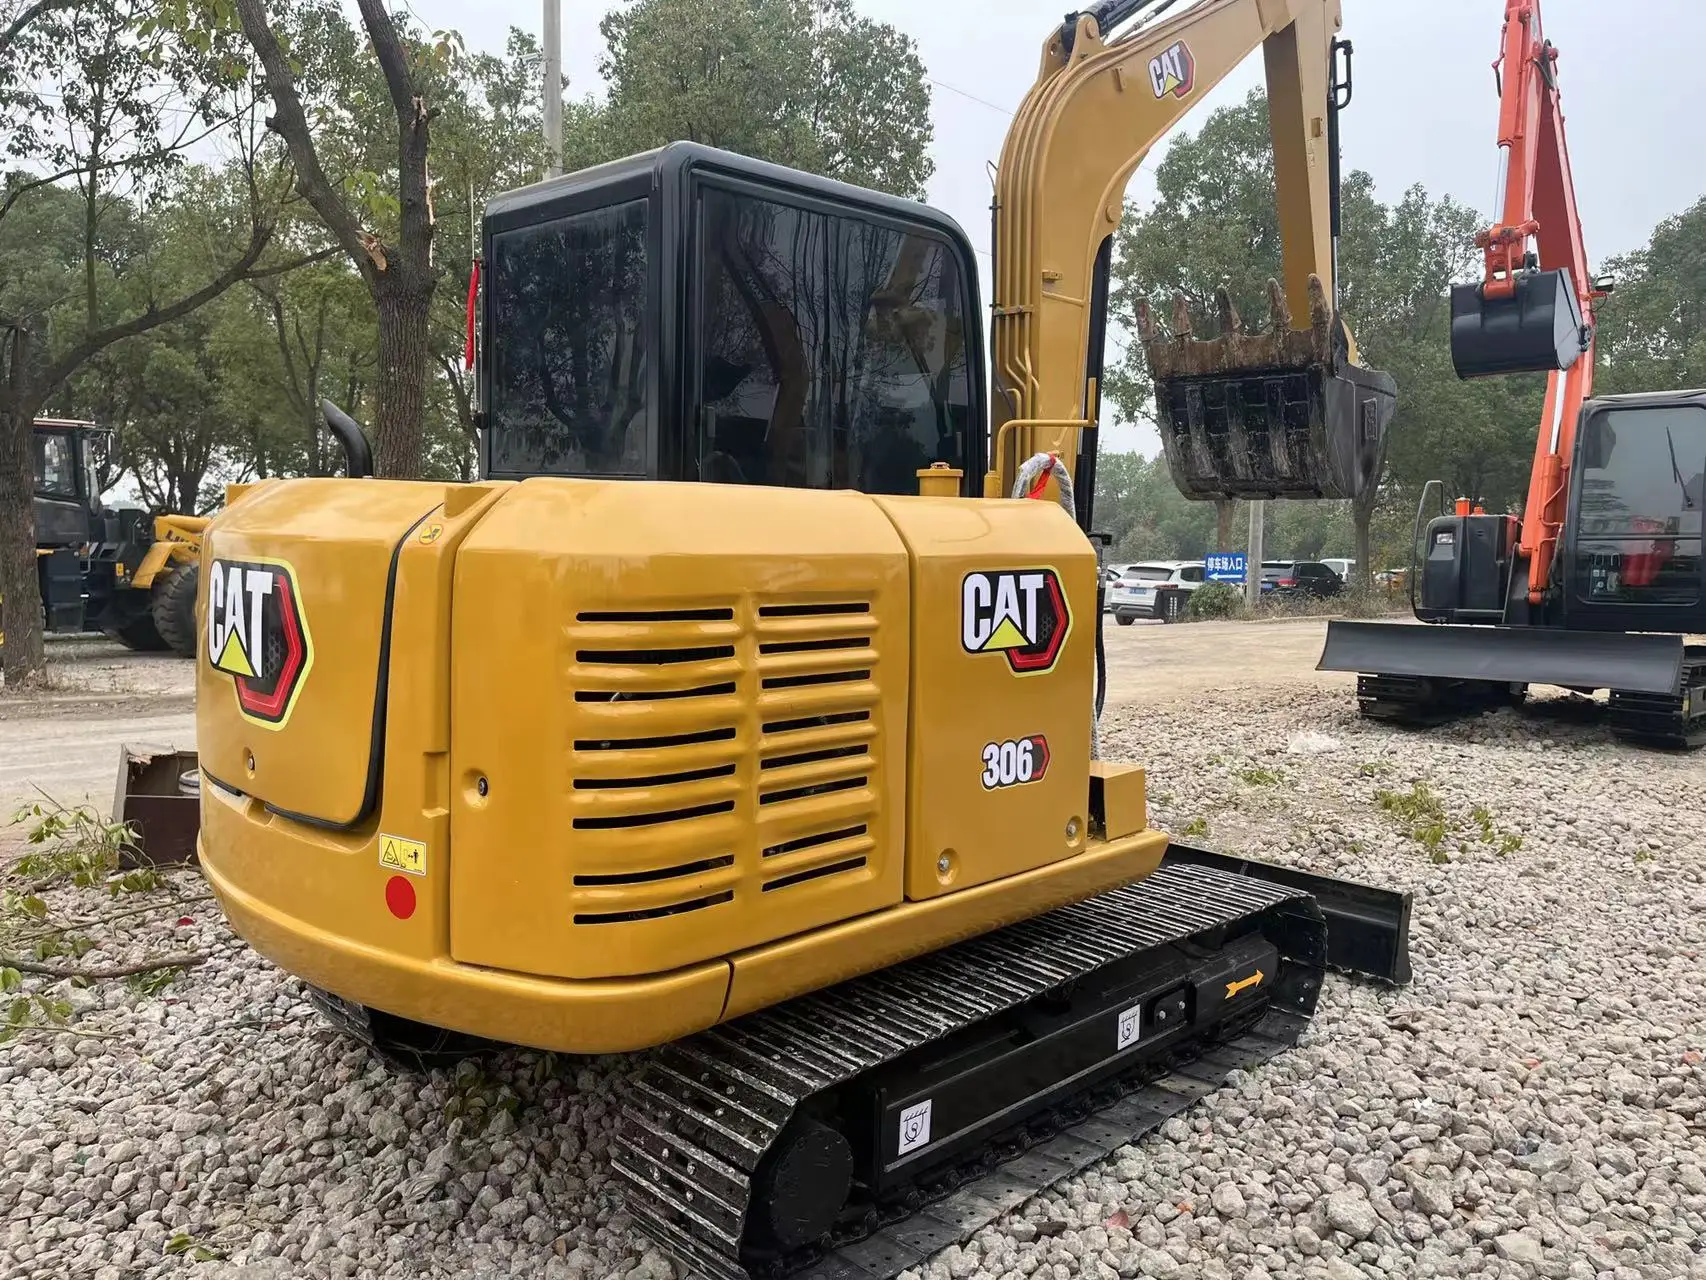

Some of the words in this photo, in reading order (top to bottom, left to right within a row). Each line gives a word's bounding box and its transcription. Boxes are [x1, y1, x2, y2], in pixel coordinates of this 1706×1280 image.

[1149, 44, 1184, 97] CAT
[1207, 556, 1243, 571] 停车场入口
[208, 560, 274, 679] CAT
[963, 573, 1044, 651] CAT
[982, 738, 1034, 788] 306
